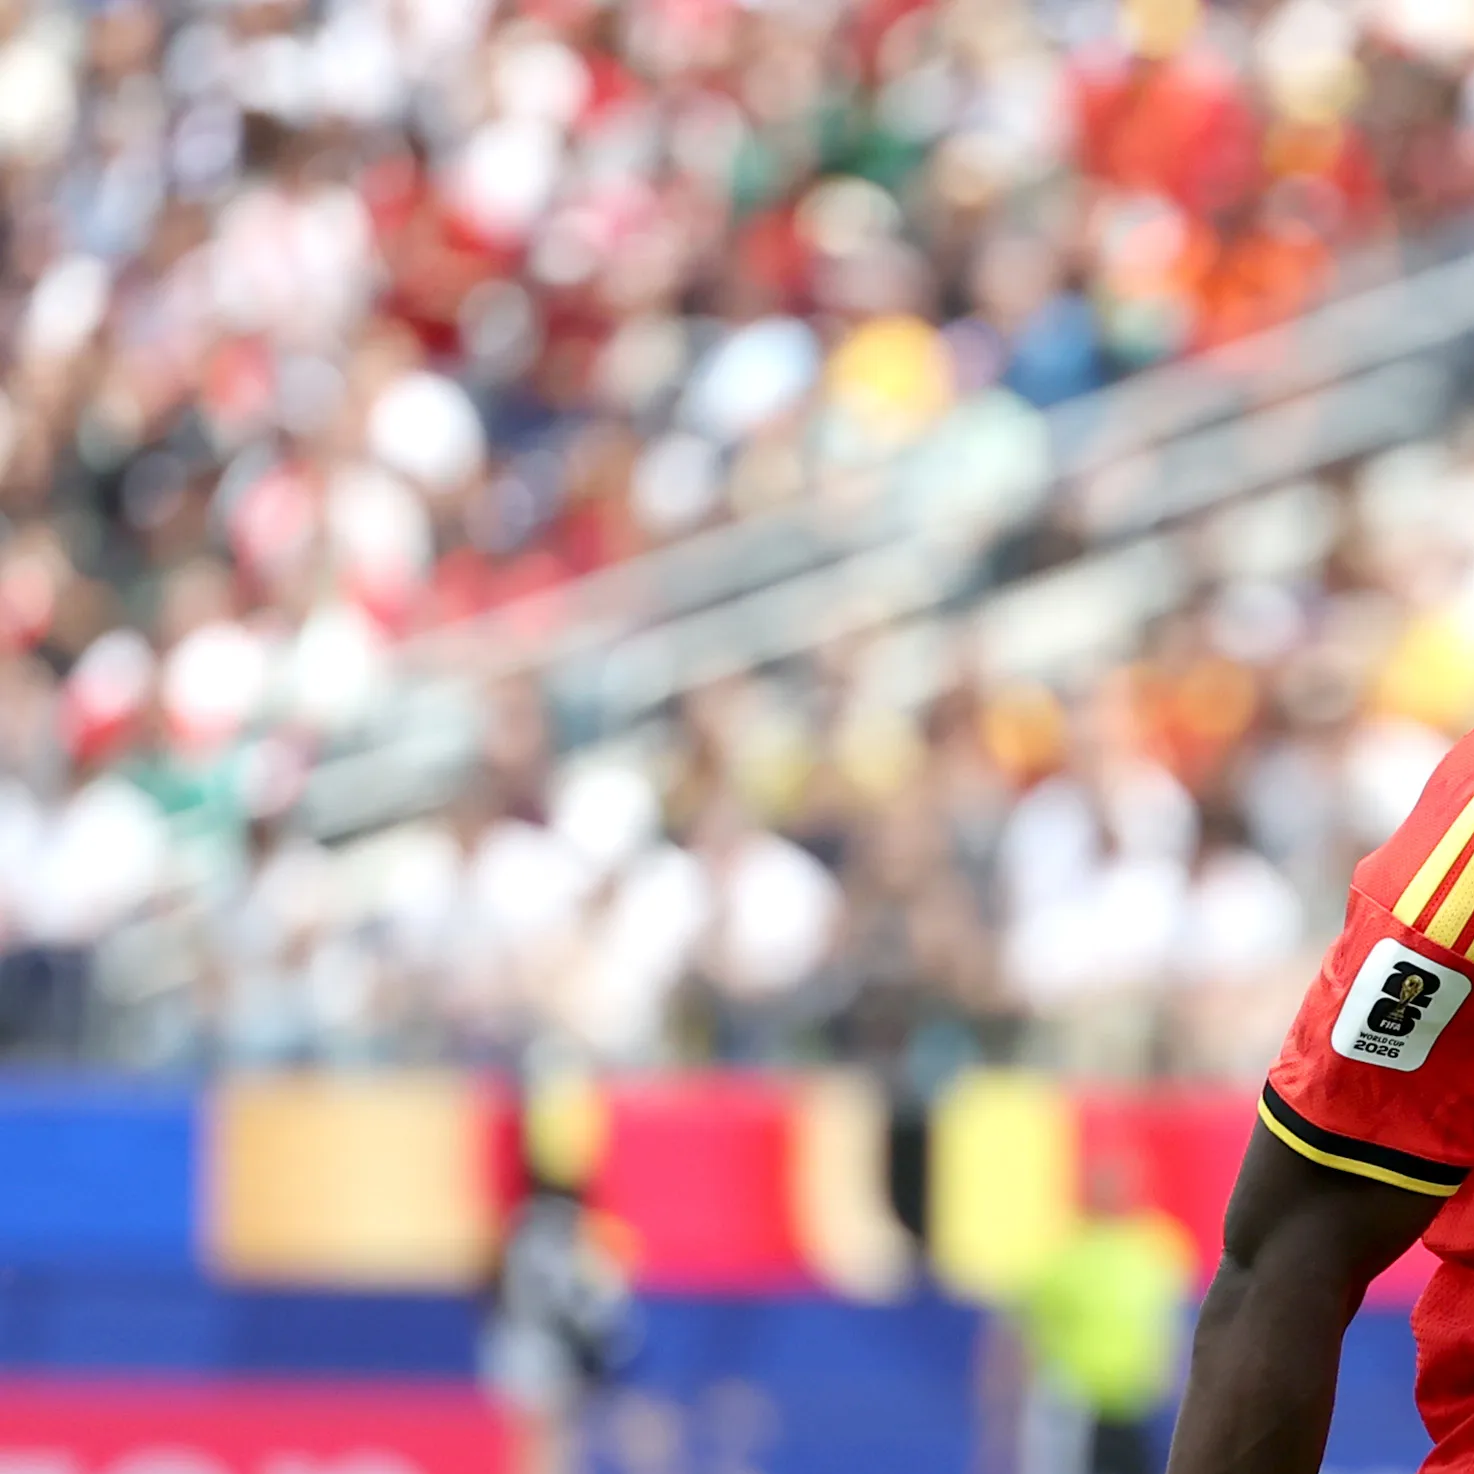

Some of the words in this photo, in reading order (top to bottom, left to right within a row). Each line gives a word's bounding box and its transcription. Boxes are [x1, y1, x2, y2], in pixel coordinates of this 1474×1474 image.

[1379, 1019, 1402, 1032] FIFA
[1360, 1031, 1388, 1044] WORLD
[1388, 1039, 1405, 1048] CUP
[1353, 1040, 1401, 1059] 2026
